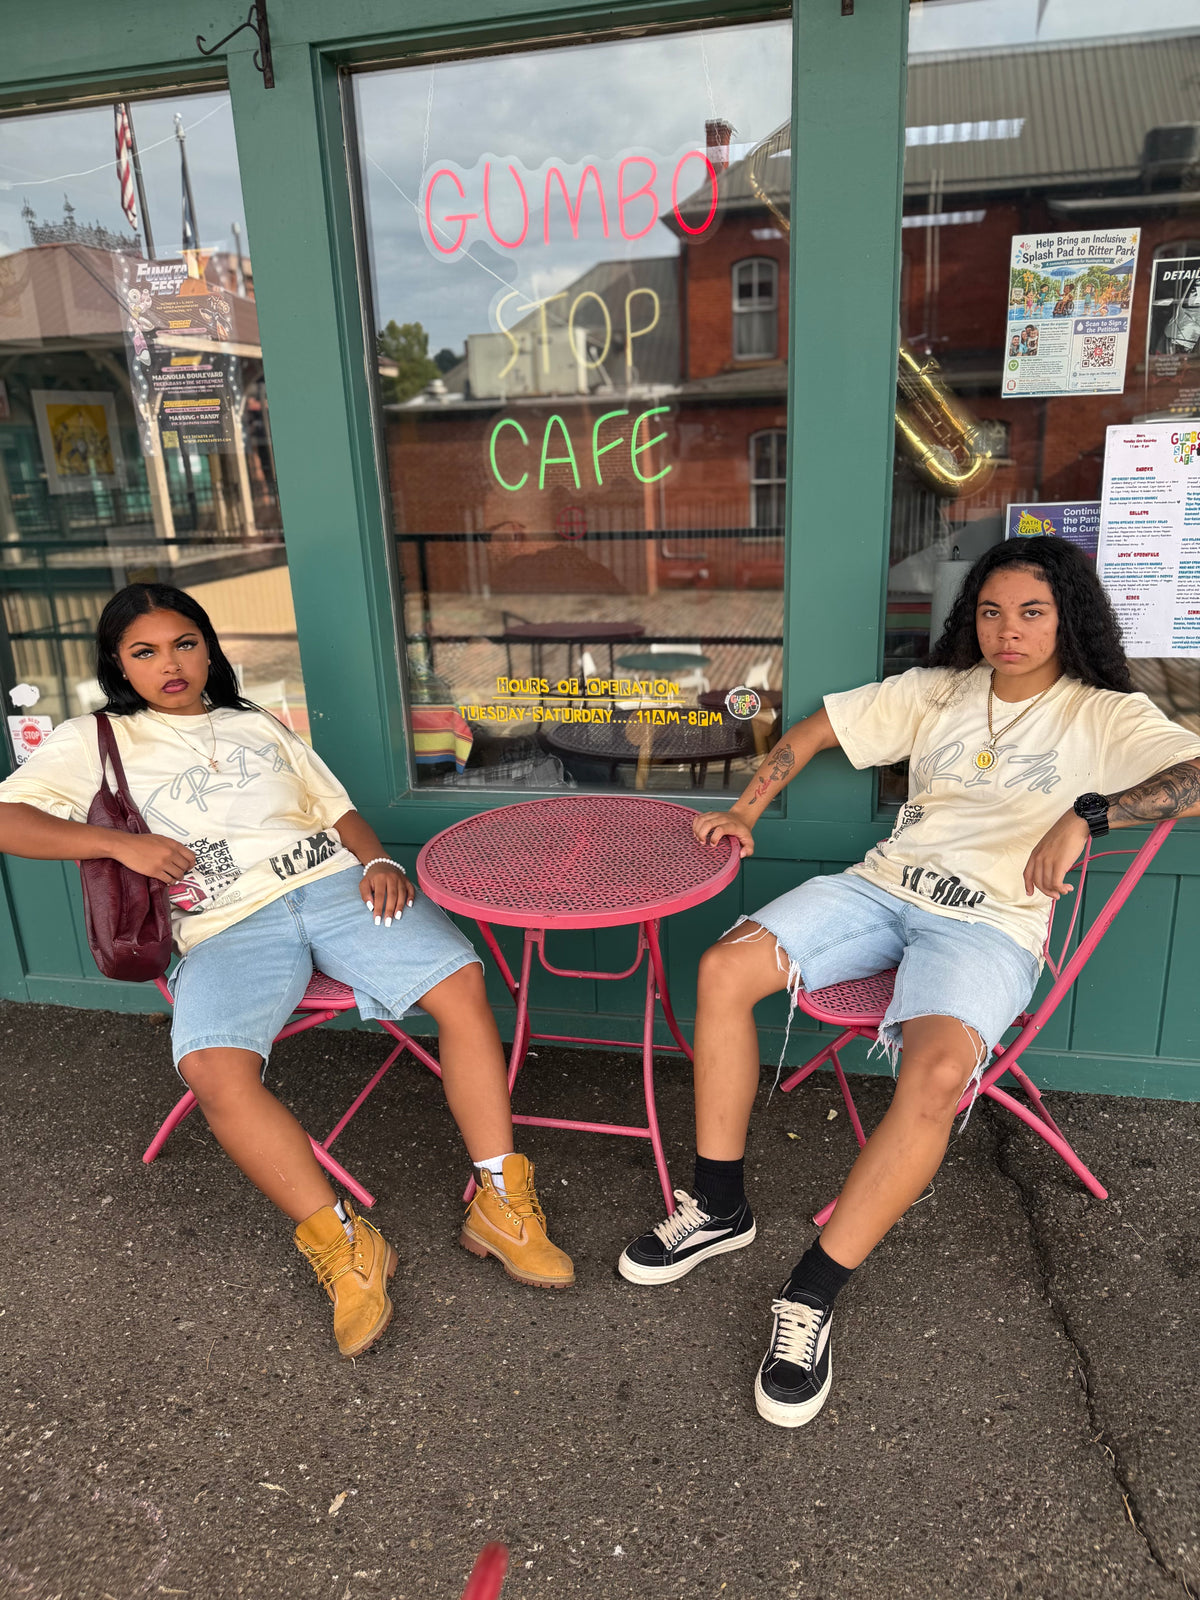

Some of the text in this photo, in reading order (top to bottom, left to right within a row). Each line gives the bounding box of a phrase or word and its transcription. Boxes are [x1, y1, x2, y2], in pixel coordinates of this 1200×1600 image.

[425, 150, 718, 254] GUMBO
[1036, 238, 1054, 249] Help
[1057, 236, 1078, 246] Bring
[1093, 234, 1126, 244] Inclusive
[1022, 245, 1136, 264] Splash Pad to Ritter Park
[136, 264, 188, 282] FUNKTA
[150, 280, 183, 296] FEST
[496, 288, 660, 379] STOP
[490, 406, 672, 491] CAFE
[1174, 443, 1196, 455] STOP
[1174, 454, 1194, 465] CAFE
[497, 677, 679, 696] HOURS OF OPERATION
[23, 731, 40, 739] STOP
[195, 839, 228, 856] OCAINE
[196, 847, 230, 865] ET'S GET
[220, 855, 233, 864] ON
